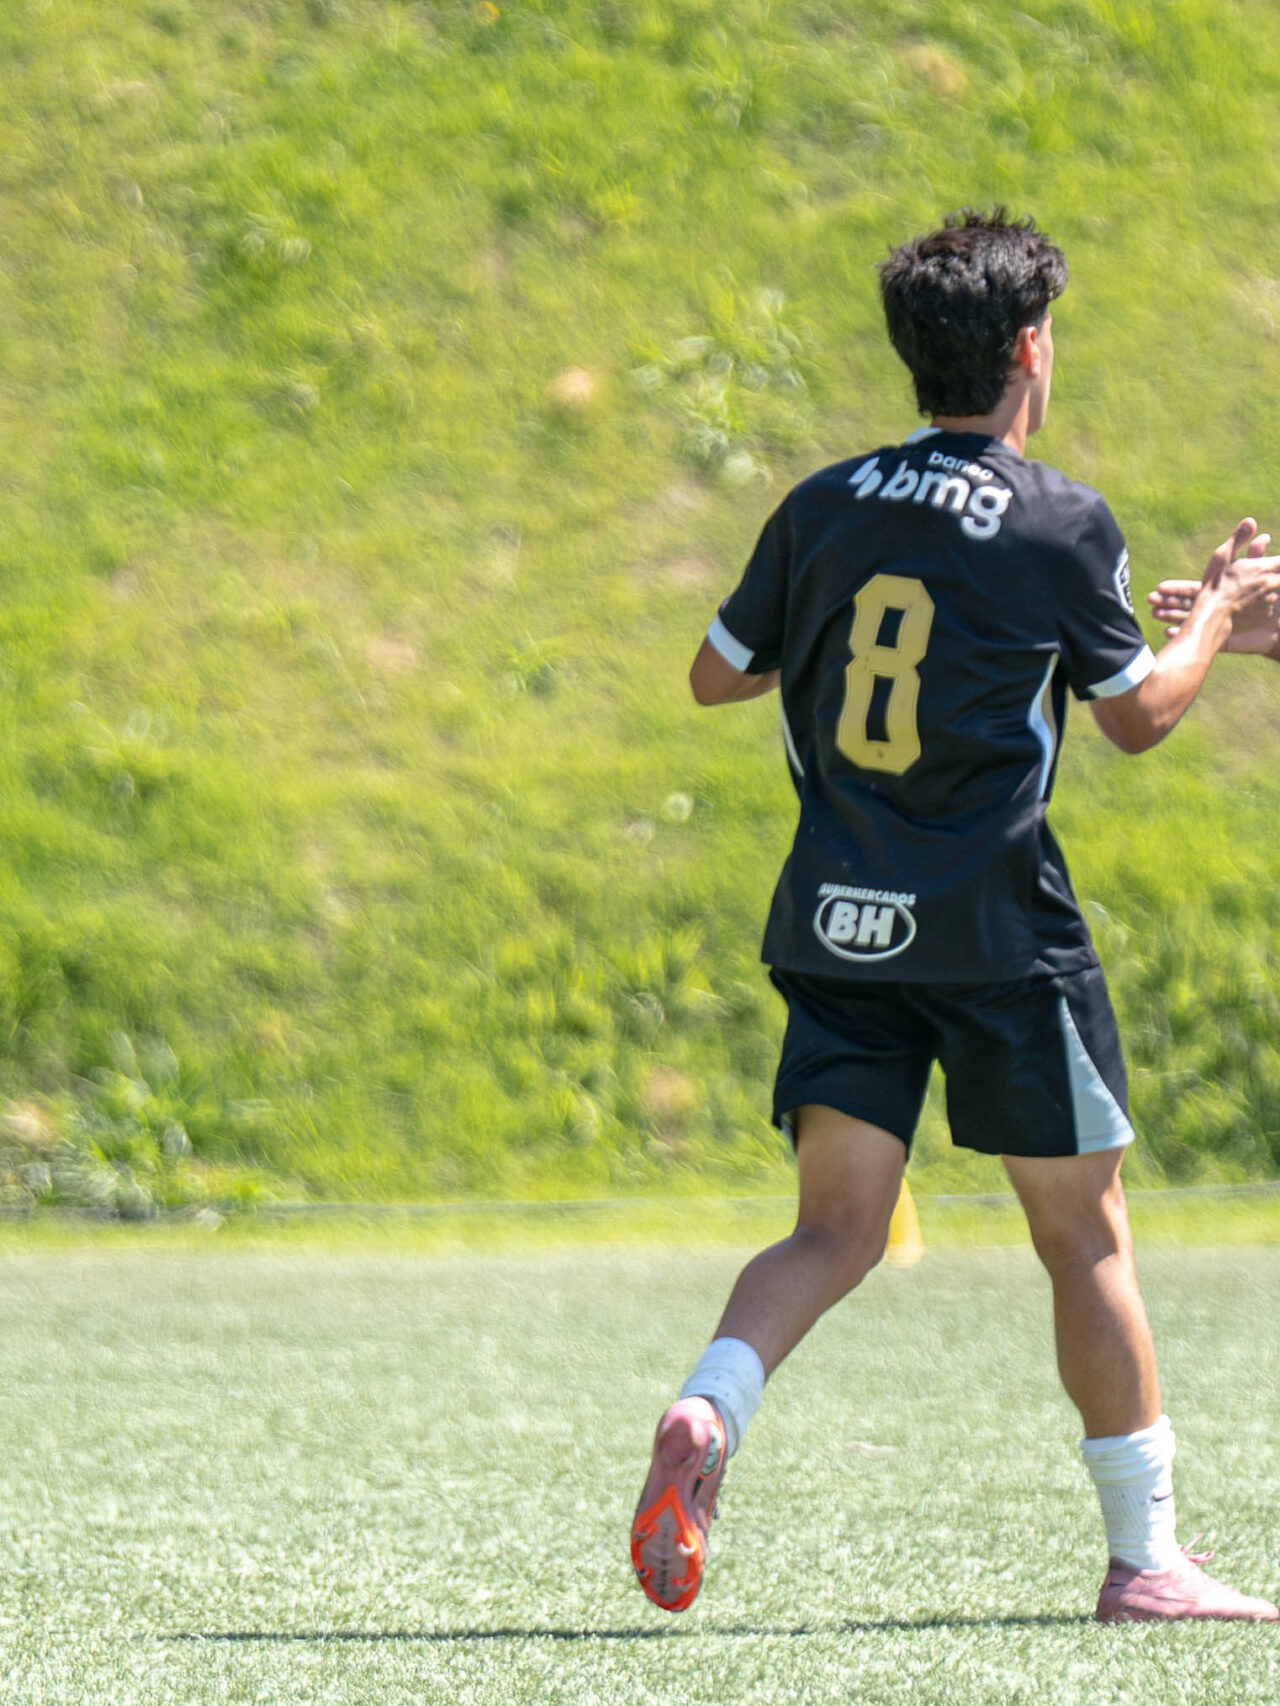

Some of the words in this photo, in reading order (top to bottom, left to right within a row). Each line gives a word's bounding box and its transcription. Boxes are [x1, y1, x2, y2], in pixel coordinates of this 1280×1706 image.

[927, 450, 995, 481] banco
[877, 459, 1014, 541] bmg
[835, 573, 936, 777] 8
[826, 900, 896, 948] BH
